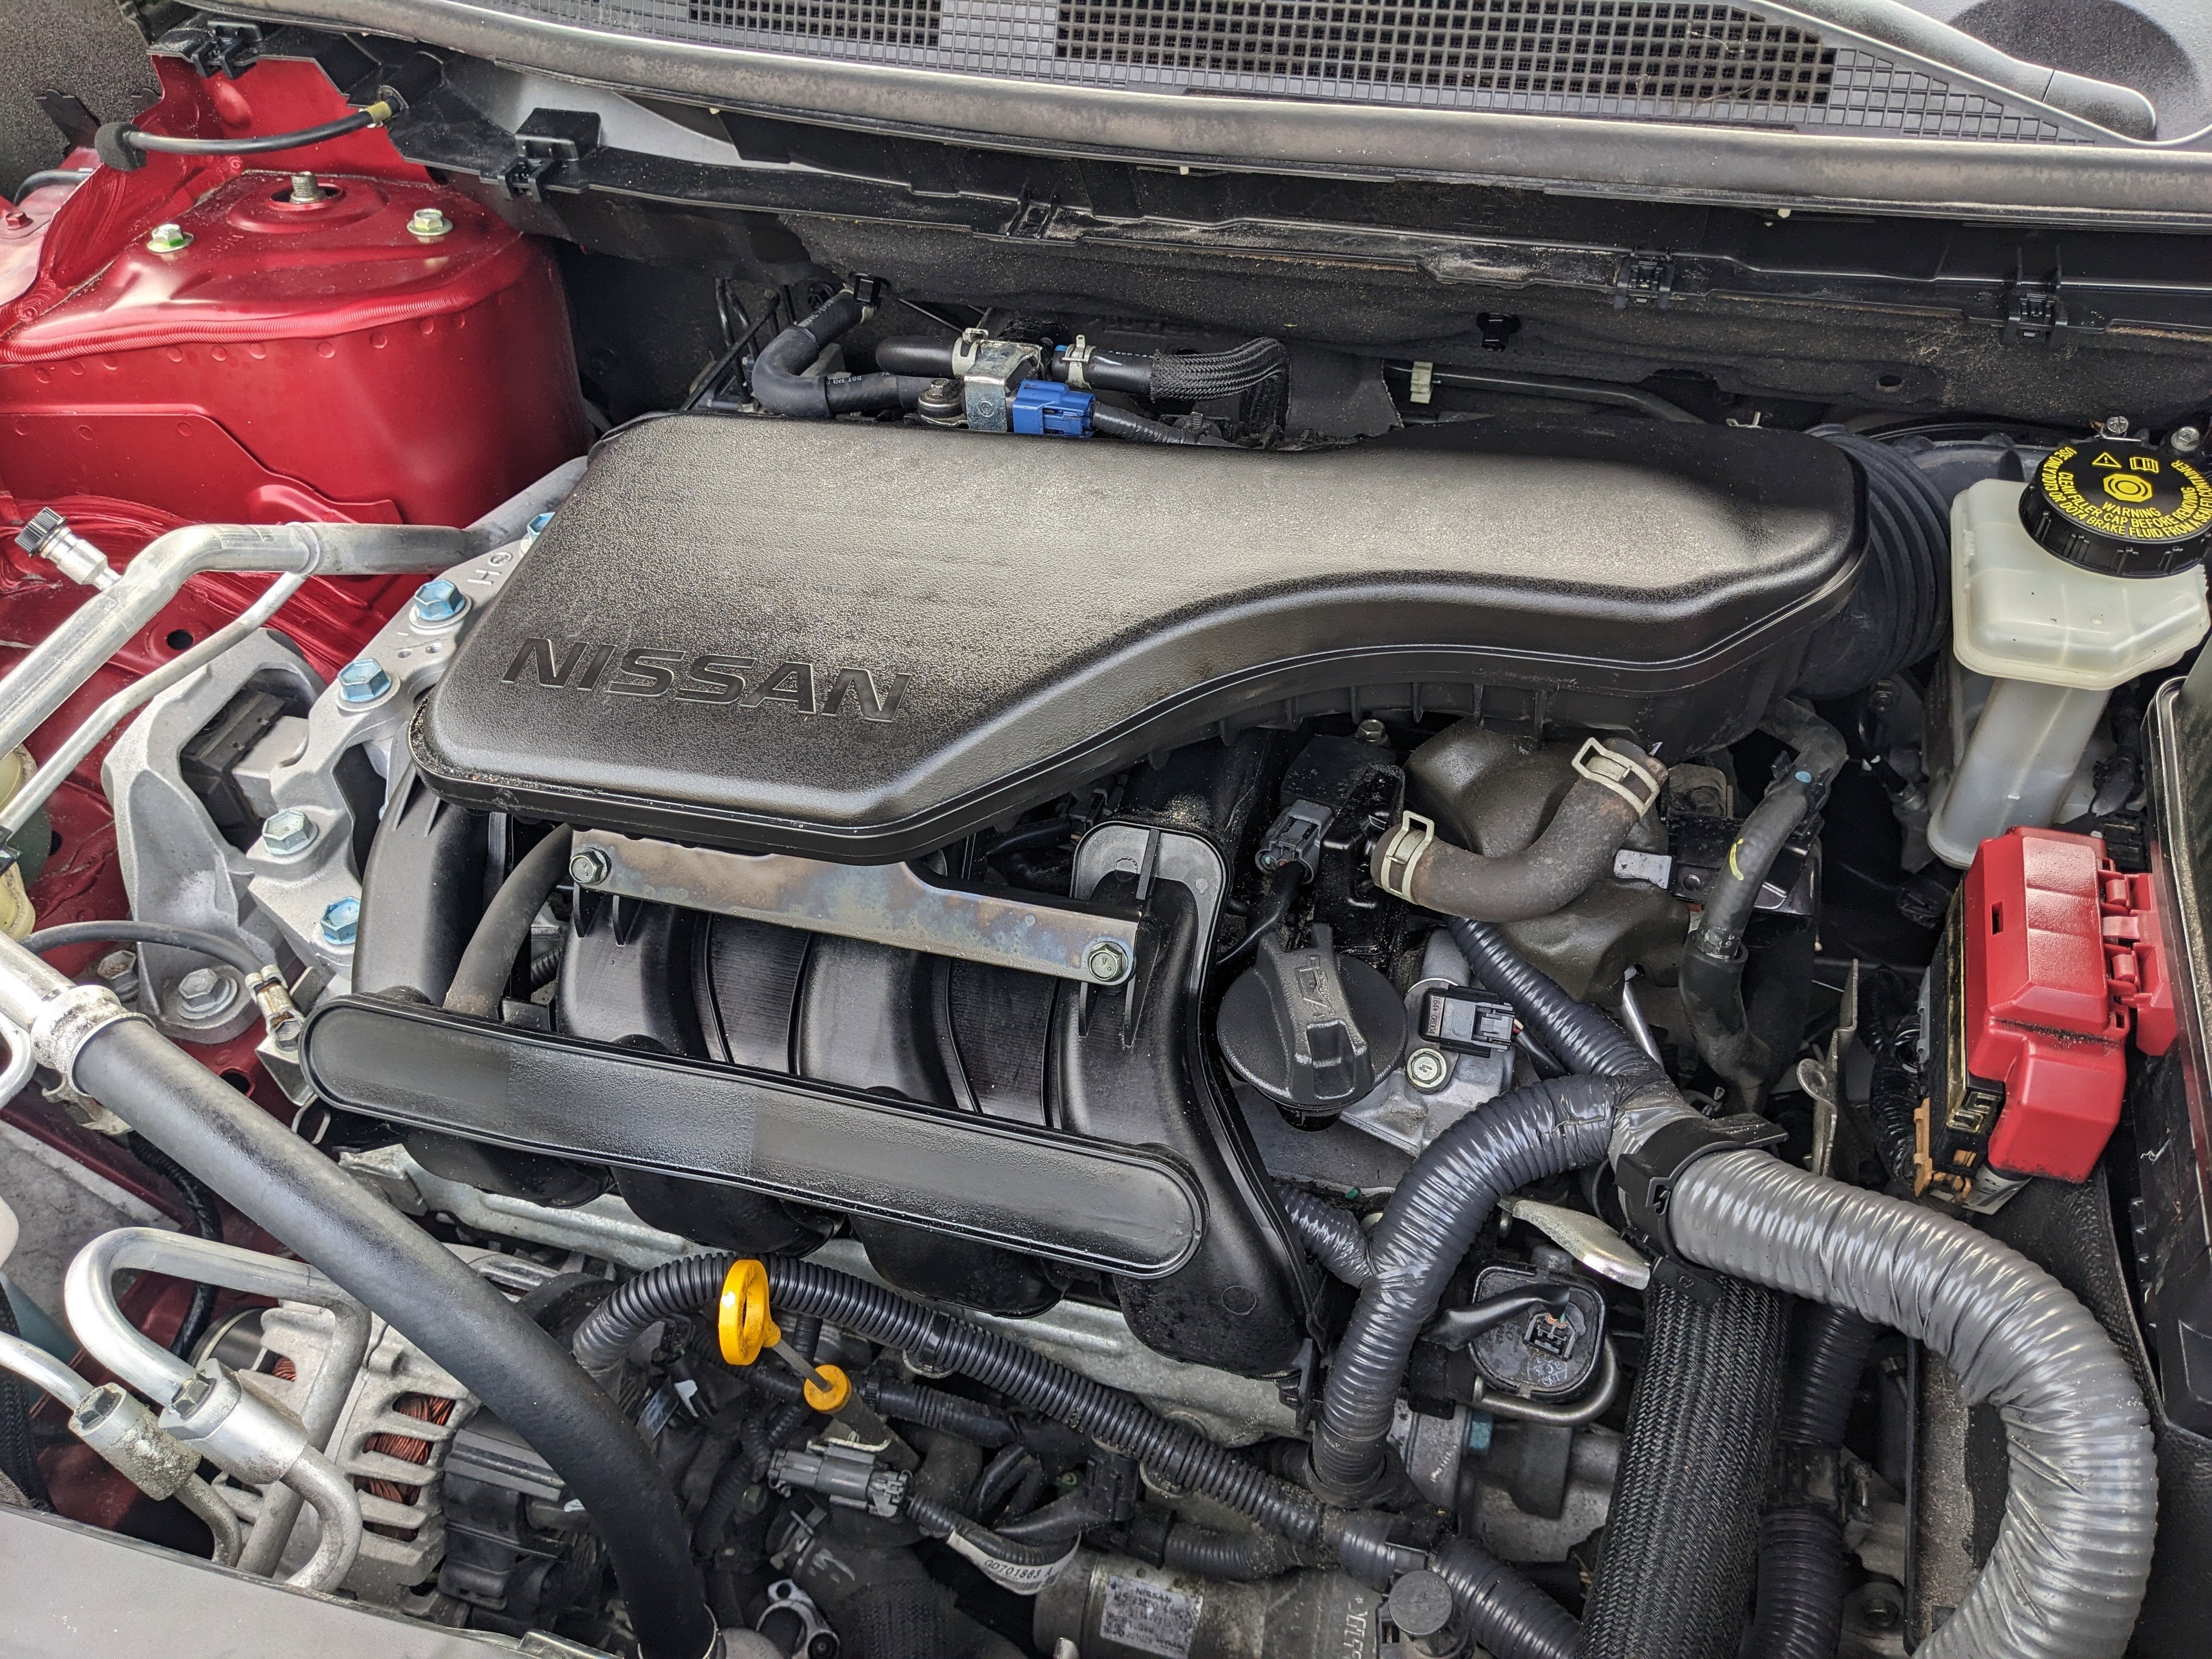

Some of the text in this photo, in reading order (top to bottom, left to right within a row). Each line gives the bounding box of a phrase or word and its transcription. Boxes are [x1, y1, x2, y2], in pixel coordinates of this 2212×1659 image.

[2054, 447, 2077, 460] USE
[2042, 456, 2063, 475] ONLY
[2171, 460, 2212, 496] CONTAINER
[2049, 491, 2067, 503] OR
[2058, 472, 2198, 528] CLEAN FILLER CAP BEFORE REMOVING
[2102, 501, 2162, 518] WARNING
[2086, 516, 2126, 535] BRAKE
[2162, 522, 2196, 537] FROM
[2188, 518, 2203, 528] A
[2129, 527, 2164, 538] FLUID
[500, 637, 911, 723] NISSAN
